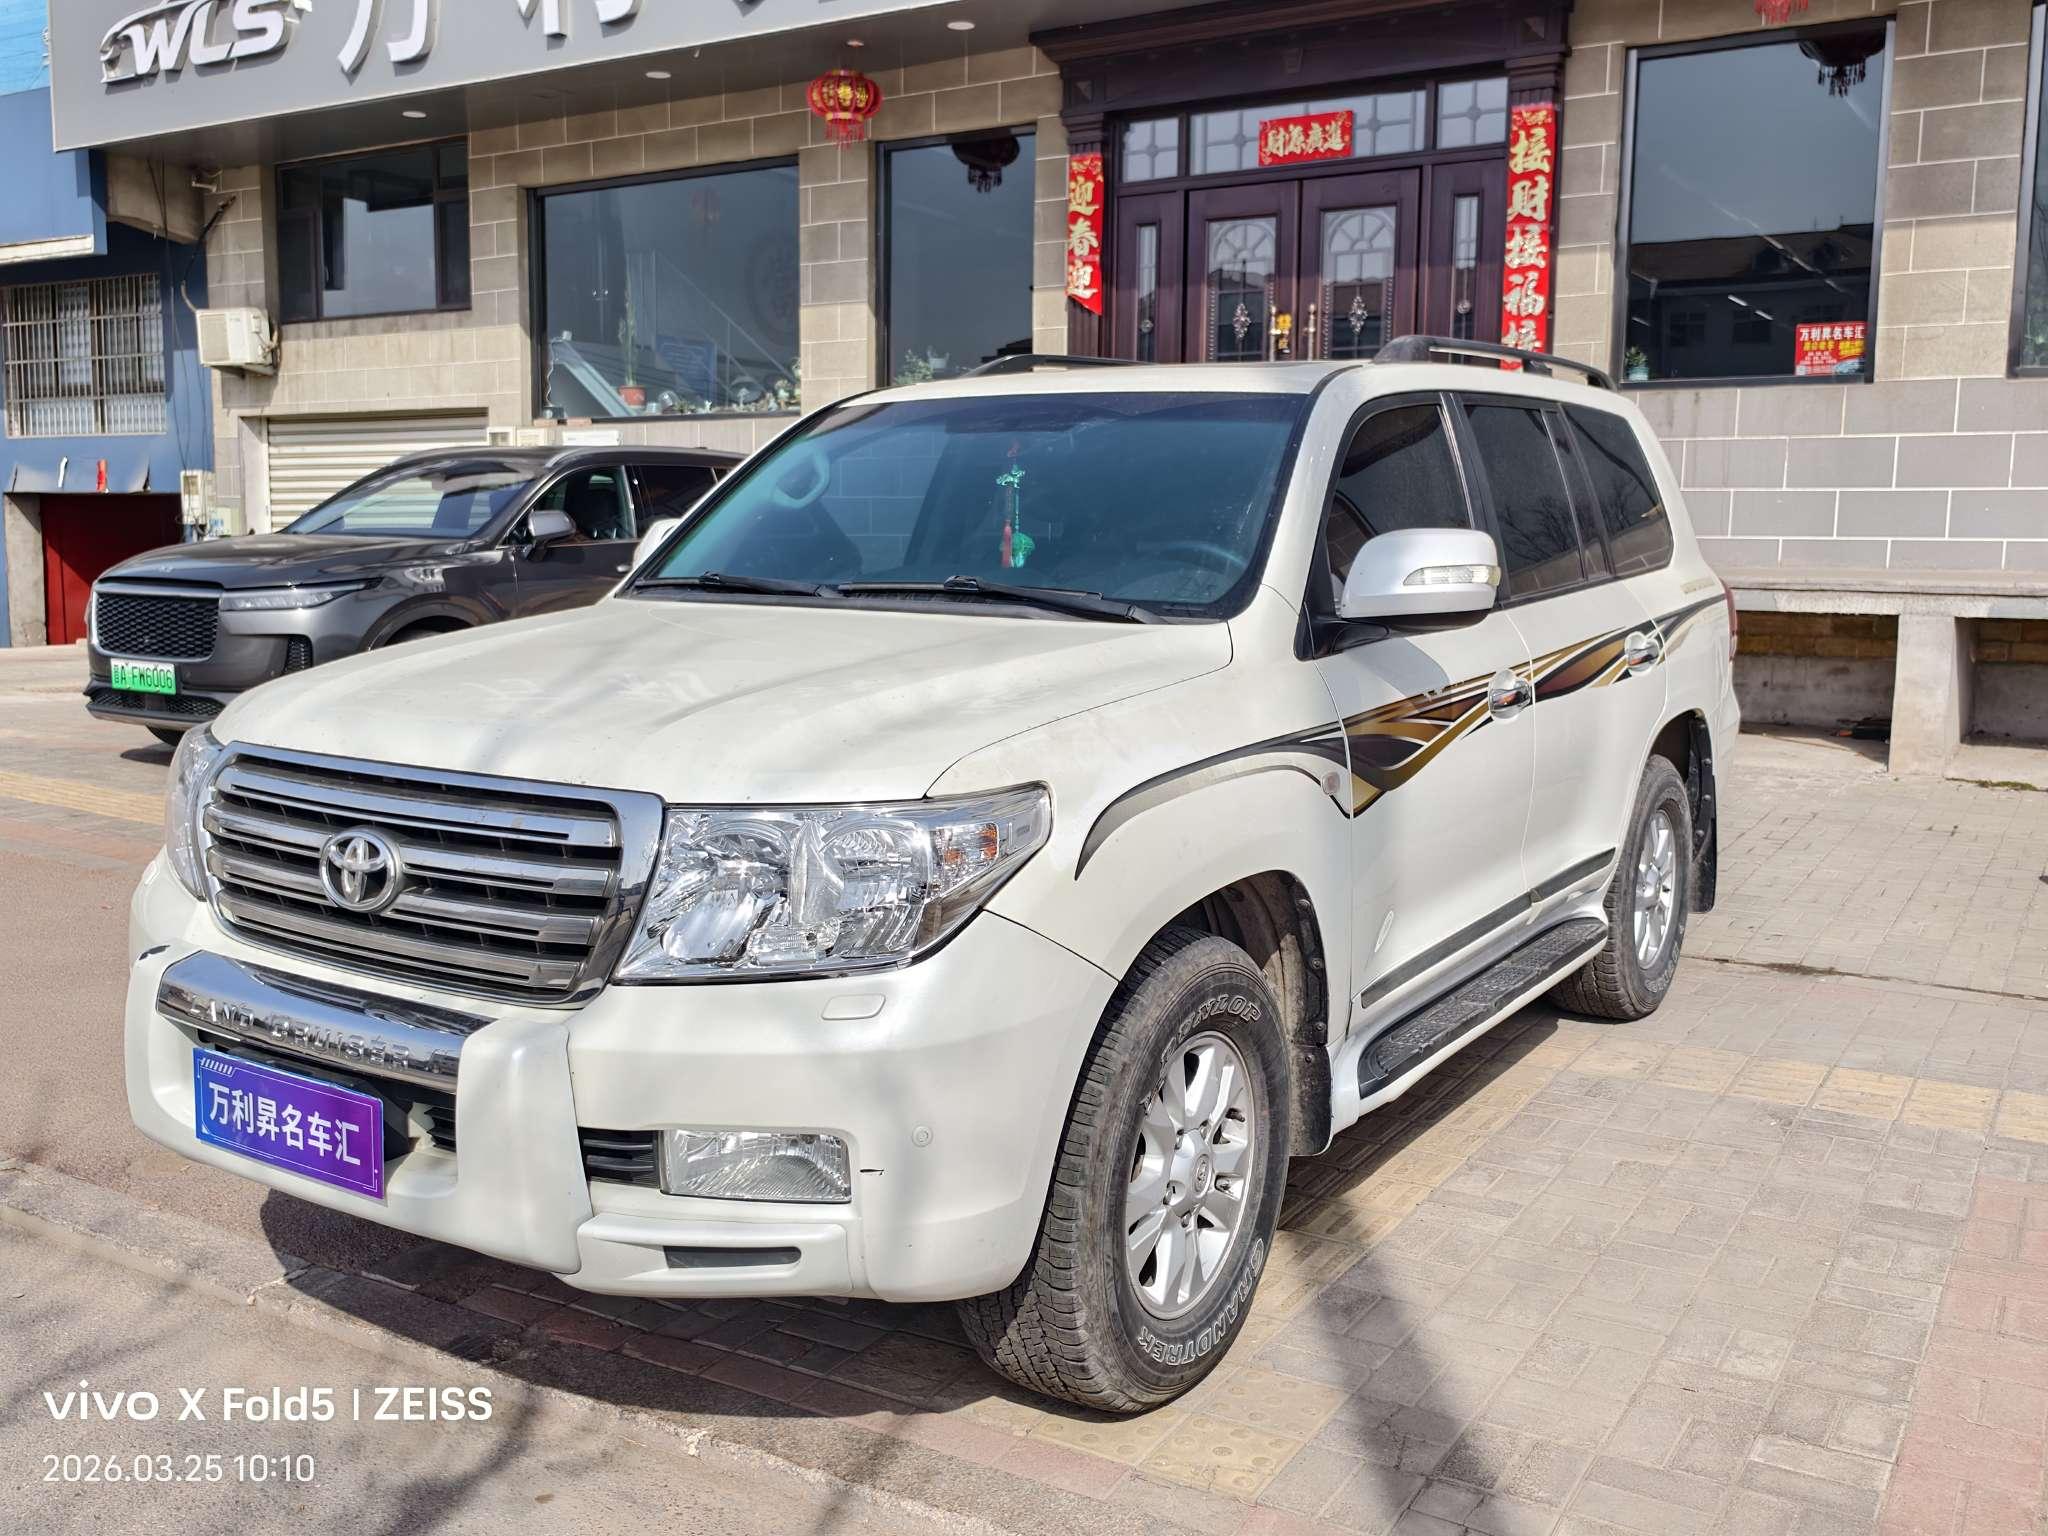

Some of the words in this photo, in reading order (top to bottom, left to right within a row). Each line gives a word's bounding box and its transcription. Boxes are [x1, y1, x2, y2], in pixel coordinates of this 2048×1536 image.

[117, 0, 285, 75] WLS
[1068, 176, 1100, 299] 迎春迎
[190, 994, 254, 1031] LAND
[270, 1013, 410, 1070] CRUISER
[208, 1081, 361, 1166] 万利昇名车汇
[1138, 1238, 1264, 1367] GRANDTREK
